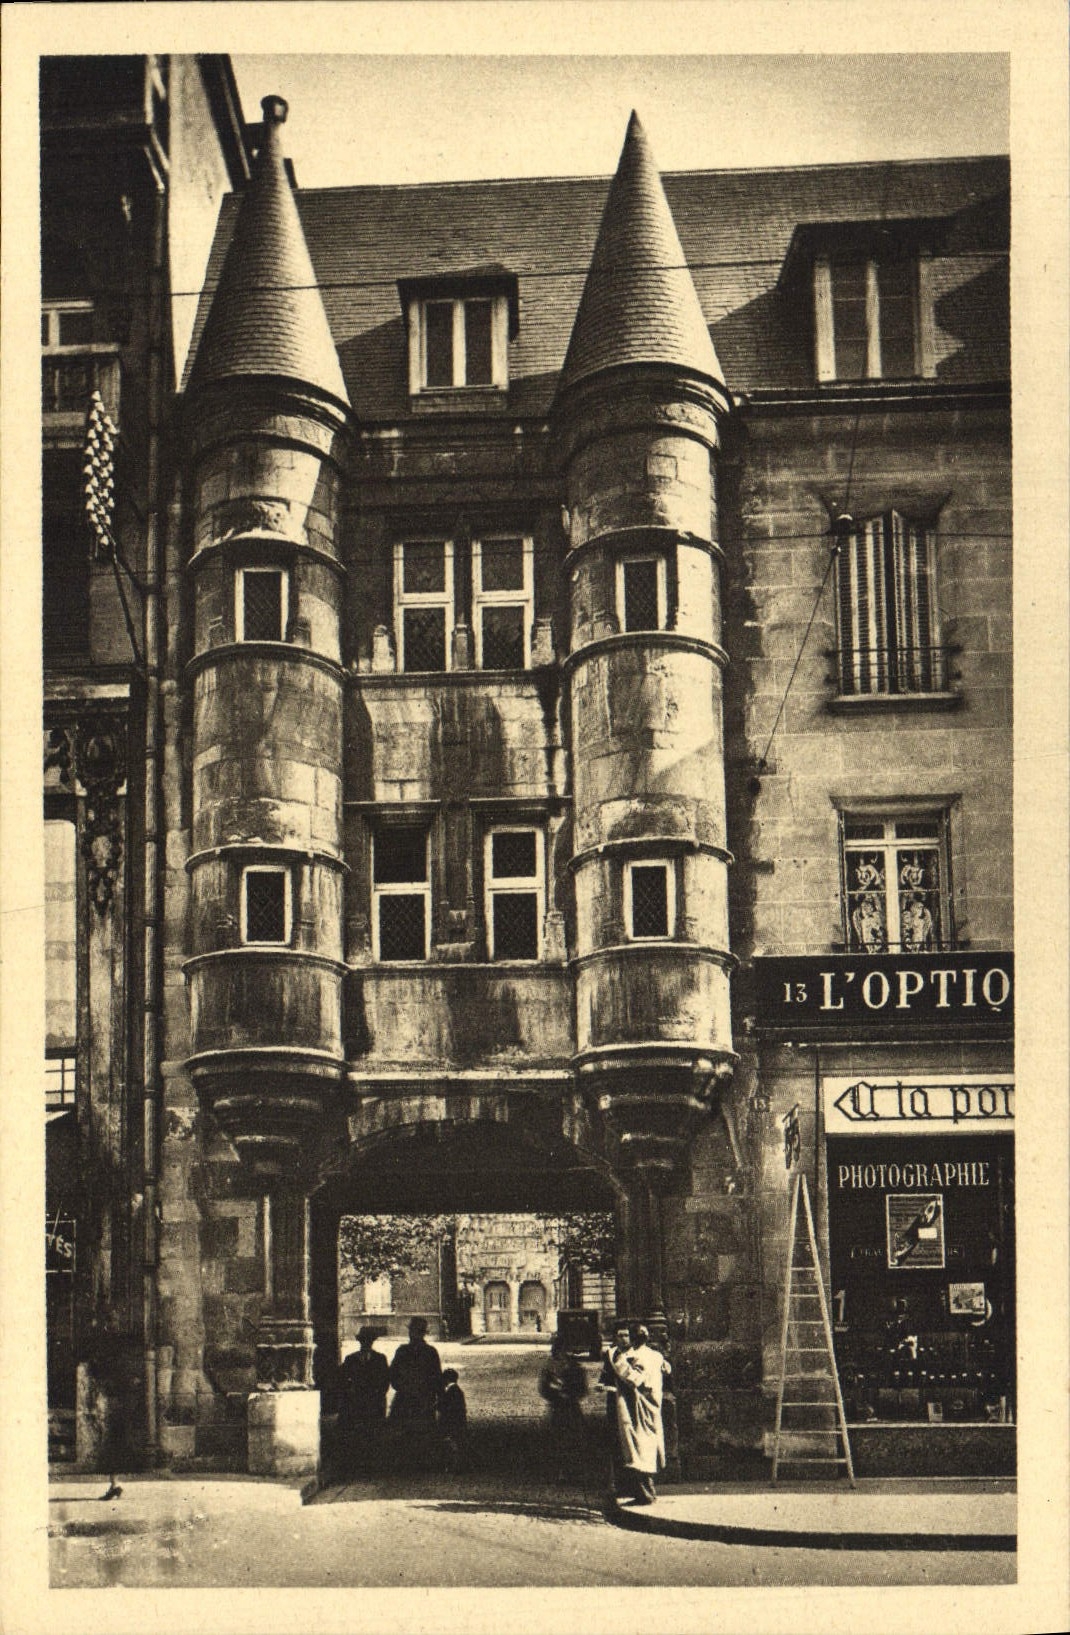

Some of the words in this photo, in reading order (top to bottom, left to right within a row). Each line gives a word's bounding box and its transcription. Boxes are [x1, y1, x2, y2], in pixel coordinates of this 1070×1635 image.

[783, 982, 808, 1003] 13
[819, 967, 1011, 1012] L'OPTIQ
[838, 1162, 990, 1188] PHOTOGRAPHIE
